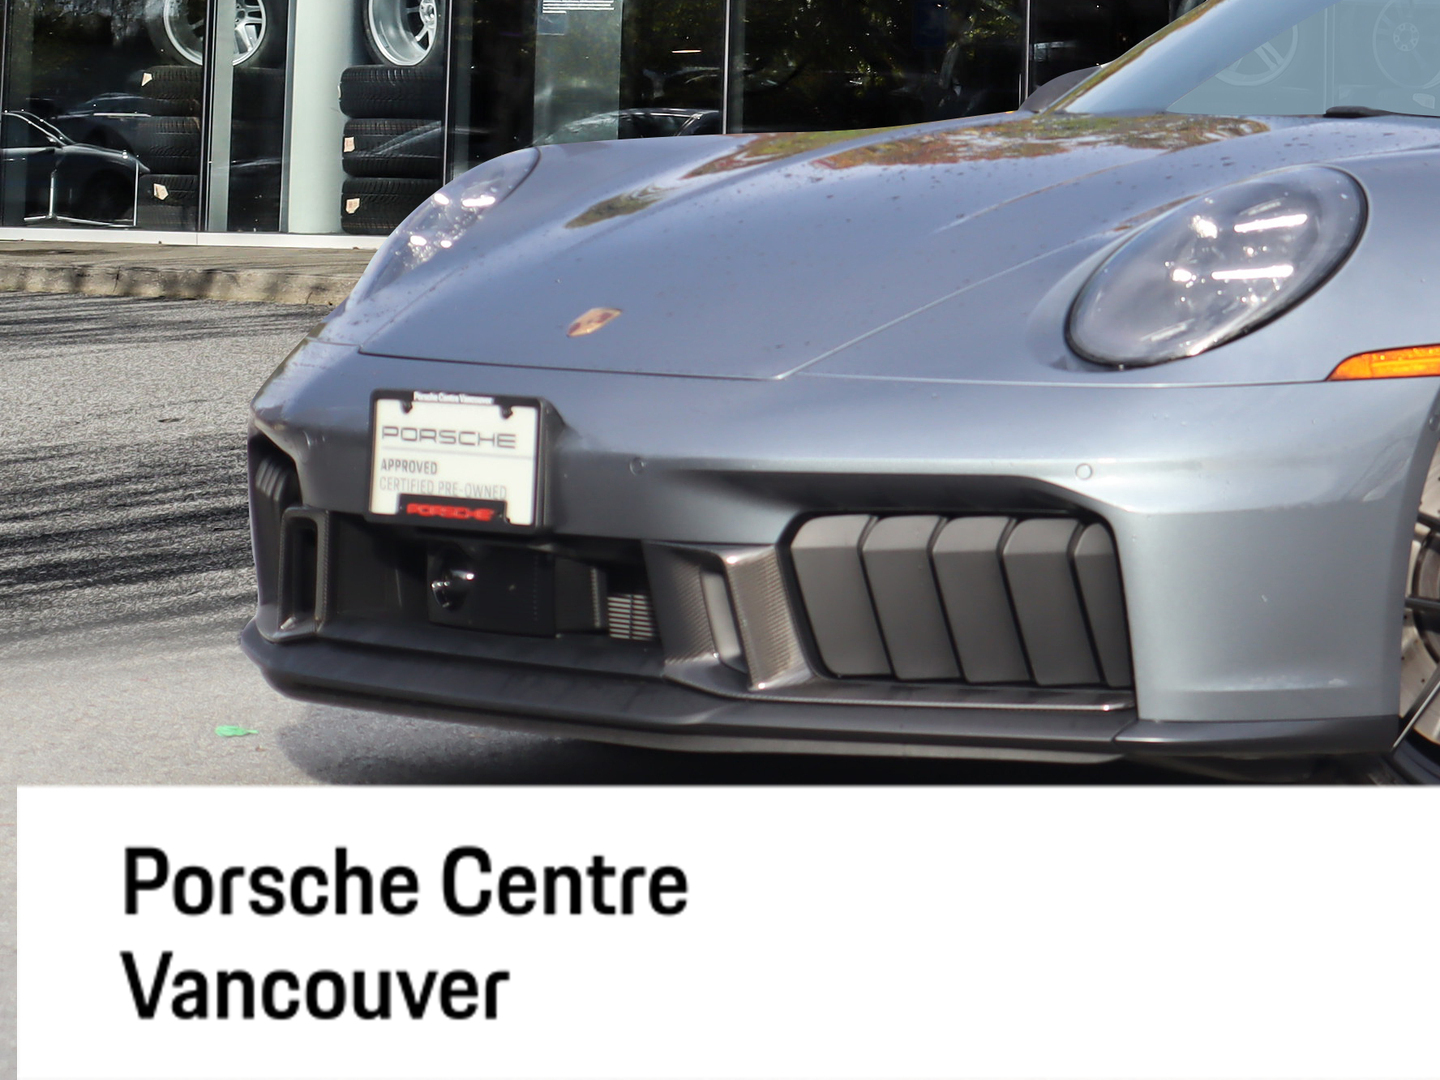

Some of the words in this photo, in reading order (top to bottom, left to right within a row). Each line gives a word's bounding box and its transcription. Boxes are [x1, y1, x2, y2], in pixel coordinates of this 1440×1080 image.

[382, 426, 516, 449] PORSCHE
[381, 458, 438, 475] APPROVED
[379, 476, 434, 495] CERTIFIED
[438, 481, 507, 500] PRE-OWNED
[407, 503, 494, 521] PORSCHE
